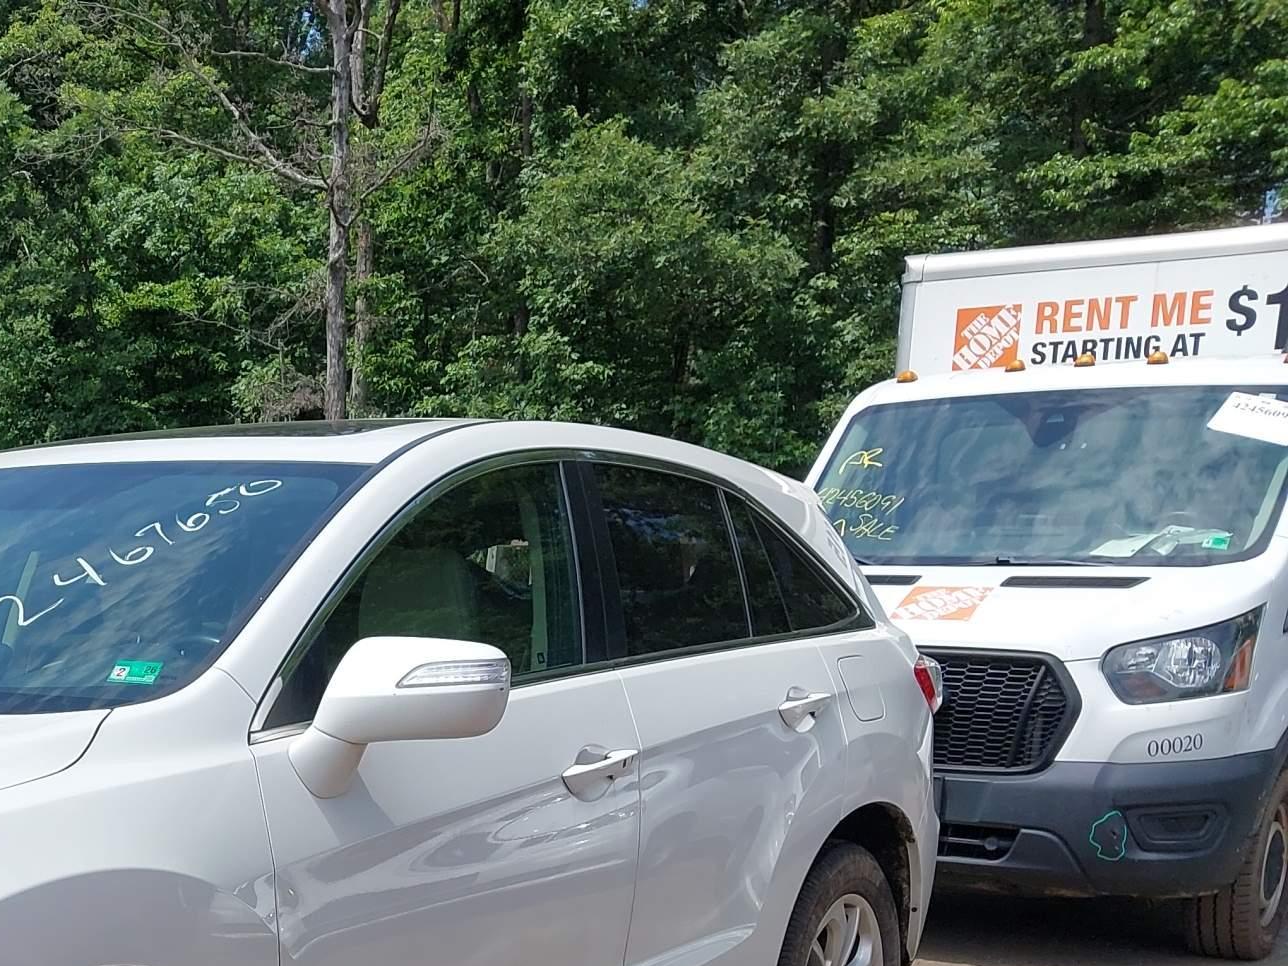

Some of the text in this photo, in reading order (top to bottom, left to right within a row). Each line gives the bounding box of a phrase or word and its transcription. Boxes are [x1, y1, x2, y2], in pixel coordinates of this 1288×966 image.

[961, 312, 990, 339] THE
[1034, 289, 1214, 335] RENT ME
[952, 304, 1021, 370] HOME
[976, 327, 1020, 368] DEPOT
[1169, 332, 1206, 357] AT
[890, 586, 987, 620] HOME
[116, 667, 127, 677] 2
[1147, 733, 1203, 757] 00020
